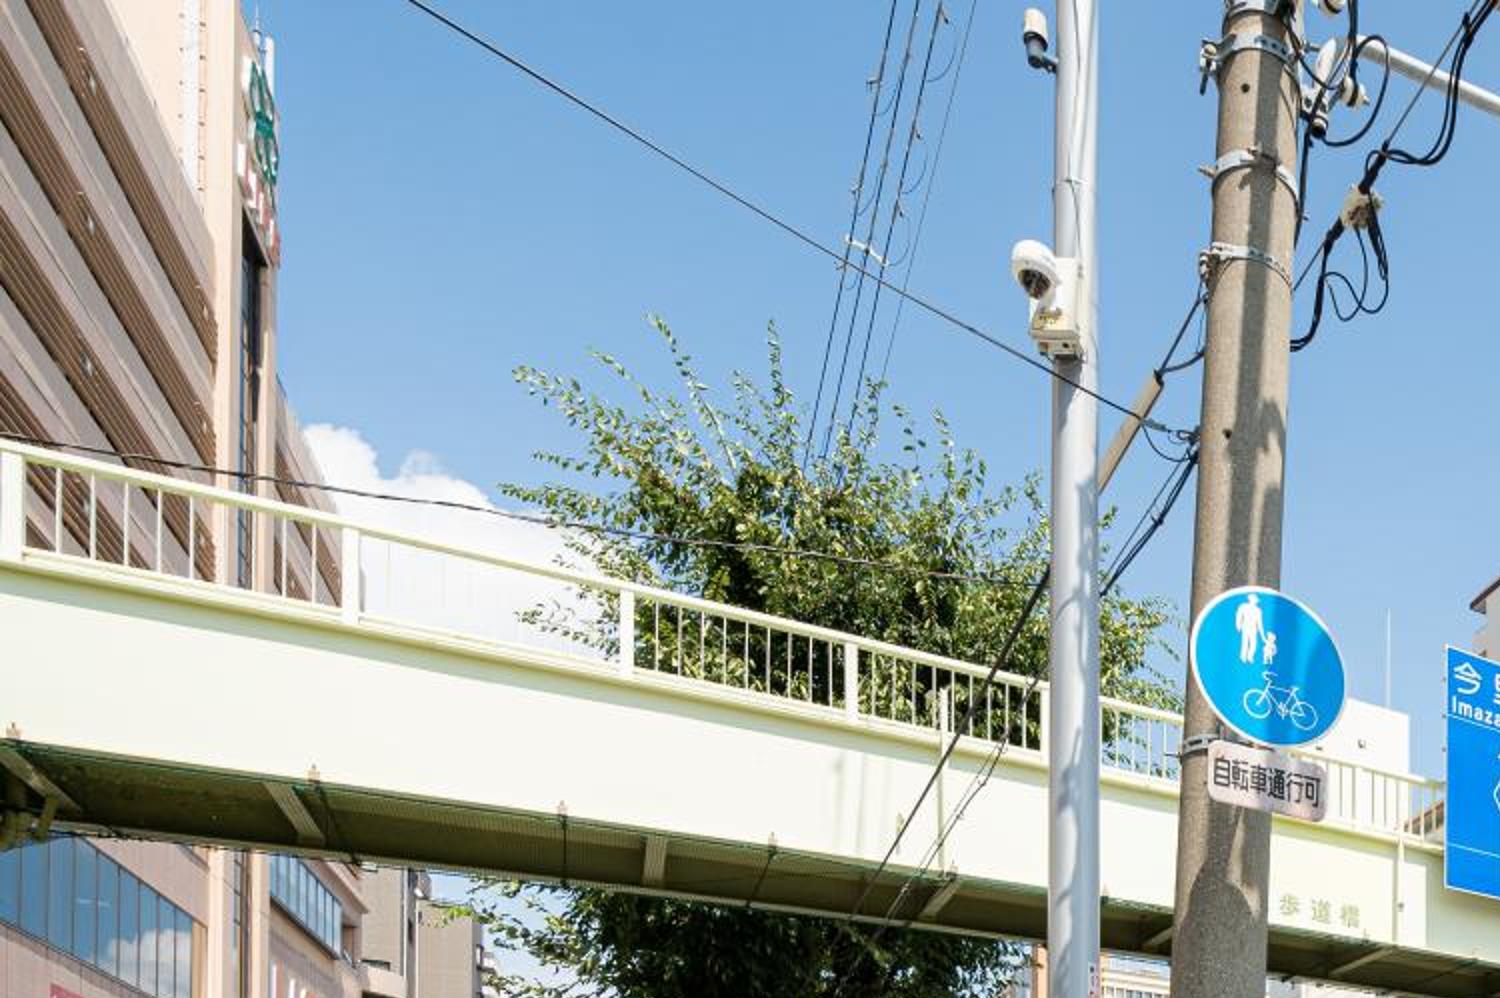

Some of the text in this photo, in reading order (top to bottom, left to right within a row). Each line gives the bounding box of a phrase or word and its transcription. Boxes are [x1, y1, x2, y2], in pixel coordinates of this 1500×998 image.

[1213, 755, 1322, 808] 自転車通行可
[1279, 893, 1360, 929] 歩道橋
